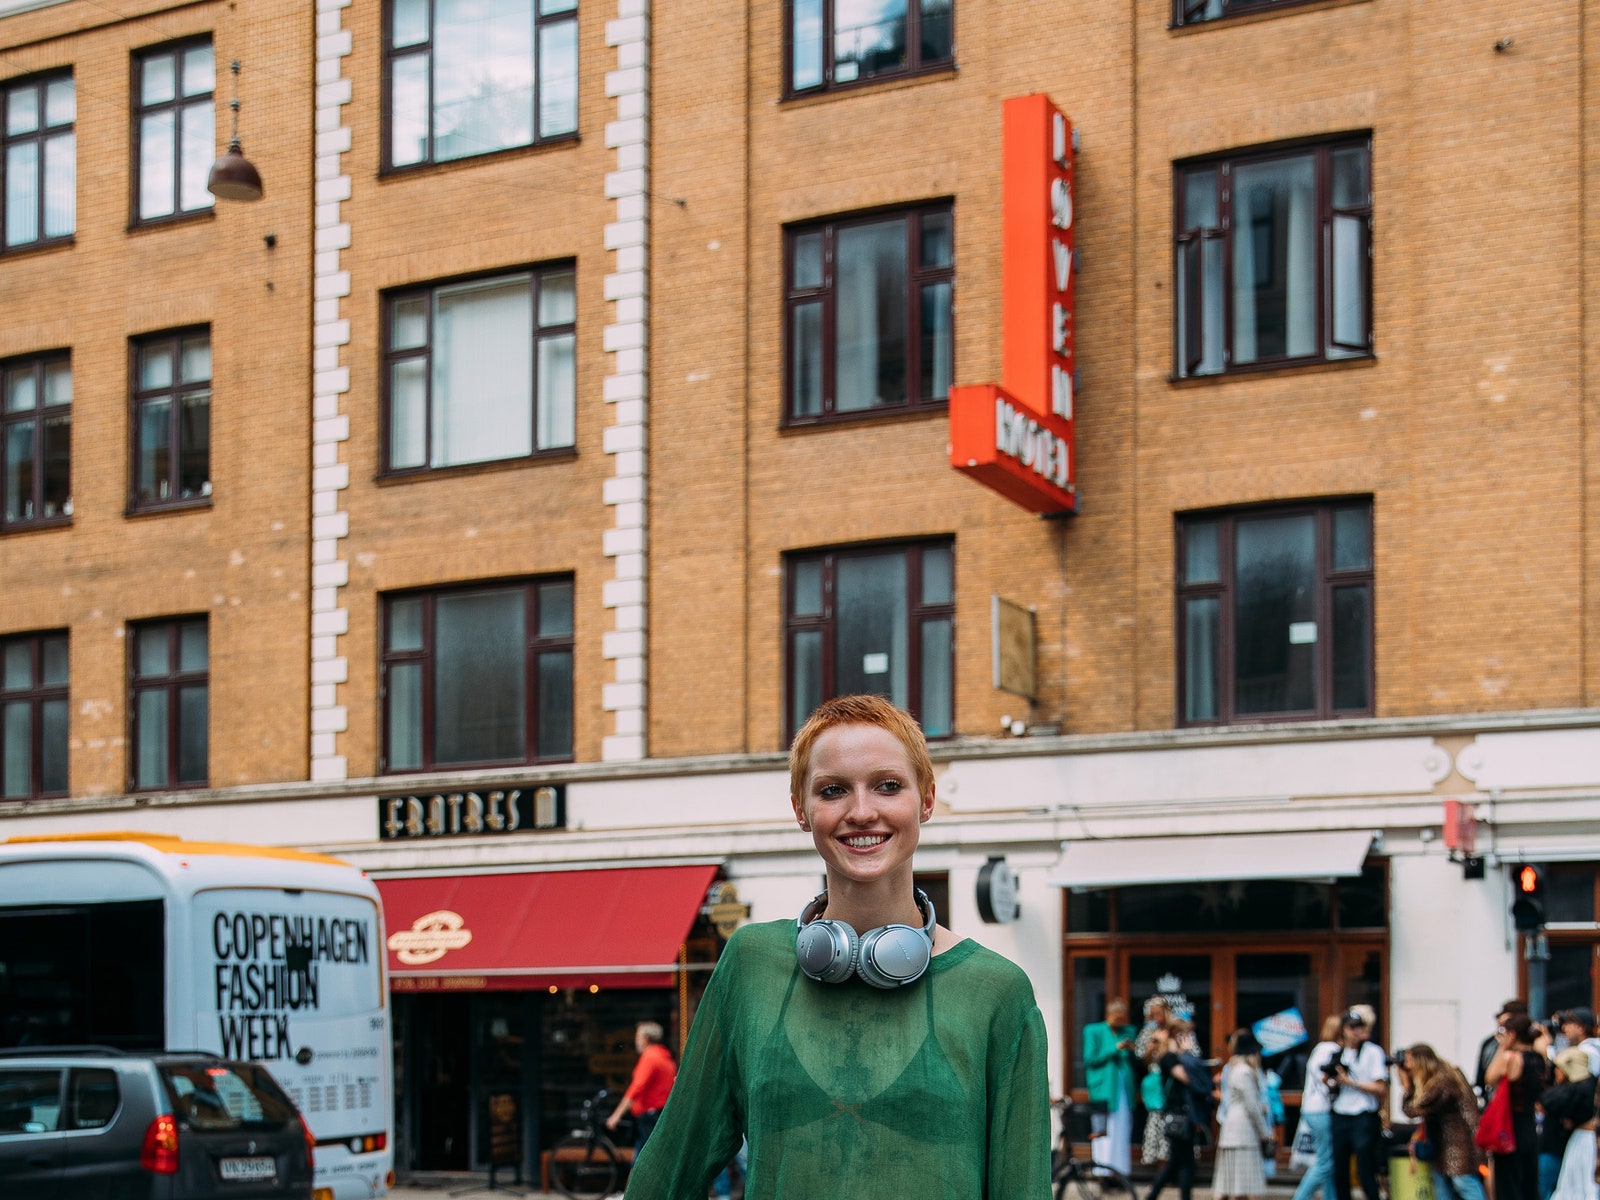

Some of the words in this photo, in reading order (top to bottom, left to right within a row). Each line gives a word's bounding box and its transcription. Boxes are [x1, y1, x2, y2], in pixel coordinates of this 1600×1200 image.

[996, 397, 1074, 492] HOTEL
[384, 790, 521, 838] FRATRES
[213, 912, 369, 964] COPENHAGEN
[215, 964, 319, 1011] FASHION
[219, 1014, 293, 1061] WEEK
